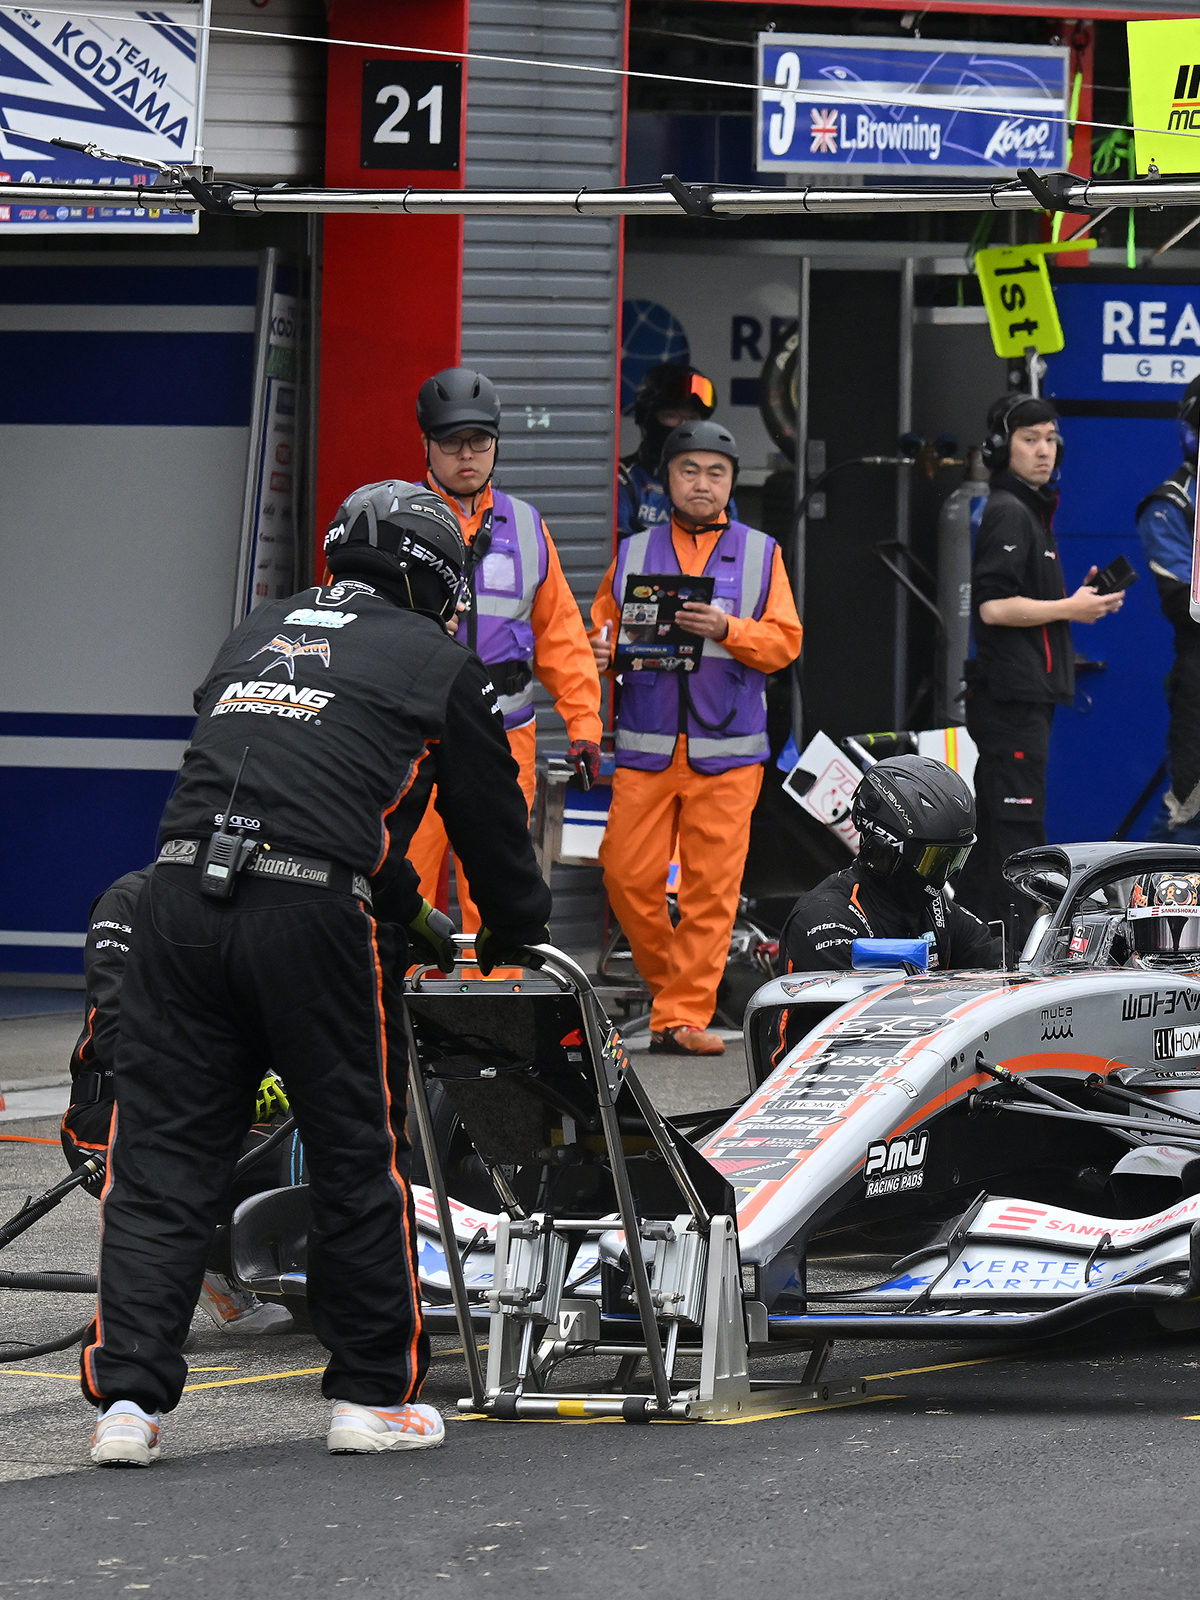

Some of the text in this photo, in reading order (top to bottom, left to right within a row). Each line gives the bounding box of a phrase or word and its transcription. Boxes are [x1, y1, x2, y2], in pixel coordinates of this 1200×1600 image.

[115, 37, 168, 89] TEAM
[51, 20, 188, 148] KODAMA
[373, 84, 444, 145] 21
[768, 51, 800, 156] 3
[840, 113, 941, 160] L.Browning
[993, 256, 1040, 339] 1st
[410, 543, 461, 595] SPARTA
[219, 681, 336, 709] INGING
[210, 701, 318, 722] MOTORSPORT
[214, 813, 261, 831] sarco
[856, 814, 906, 855] PARTA
[247, 853, 329, 884] chanix.com
[848, 903, 875, 938] sparco
[1161, 907, 1198, 915] SANKISHOKAI
[1041, 1005, 1073, 1020] muta
[829, 1054, 908, 1068] asics
[793, 1101, 849, 1109] HOMES
[717, 1139, 764, 1148] GR
[732, 1159, 790, 1177] YOKOHAMA
[866, 1172, 924, 1199] RACING PADS
[1045, 1201, 1199, 1238] SANKISHOKAI
[962, 1260, 1108, 1275] VERTEX
